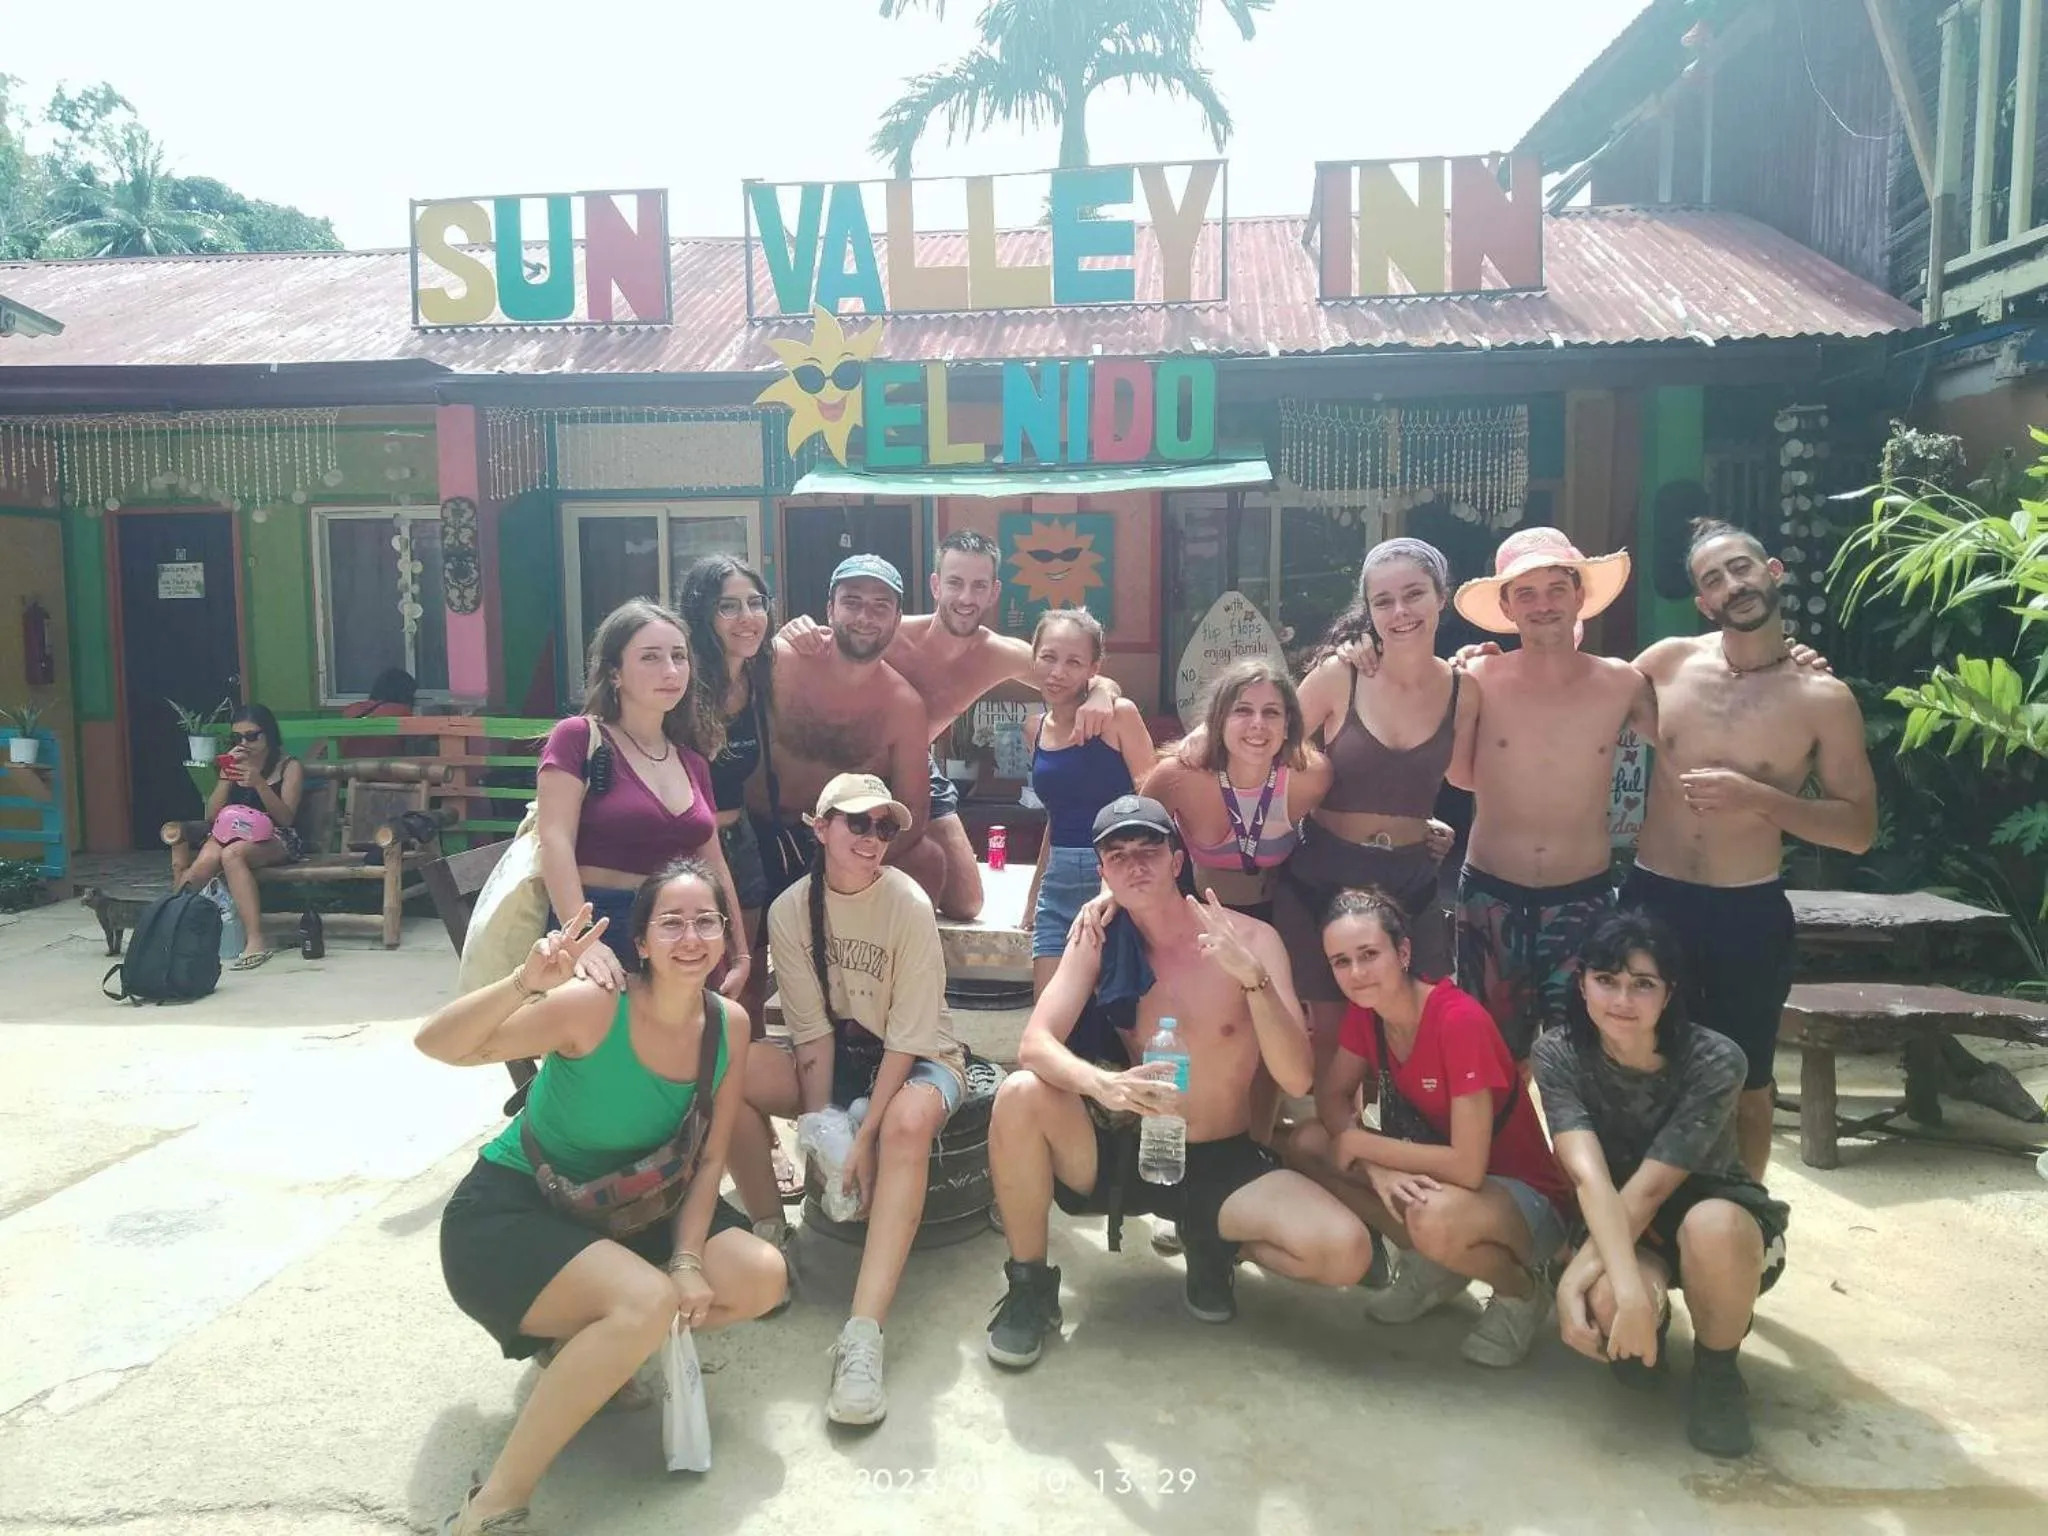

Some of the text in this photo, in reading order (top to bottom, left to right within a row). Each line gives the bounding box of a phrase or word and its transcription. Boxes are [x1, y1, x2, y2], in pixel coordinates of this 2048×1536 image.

[416, 156, 1542, 325] SUN VALLEY INN
[864, 358, 1216, 467] EL NIDO
